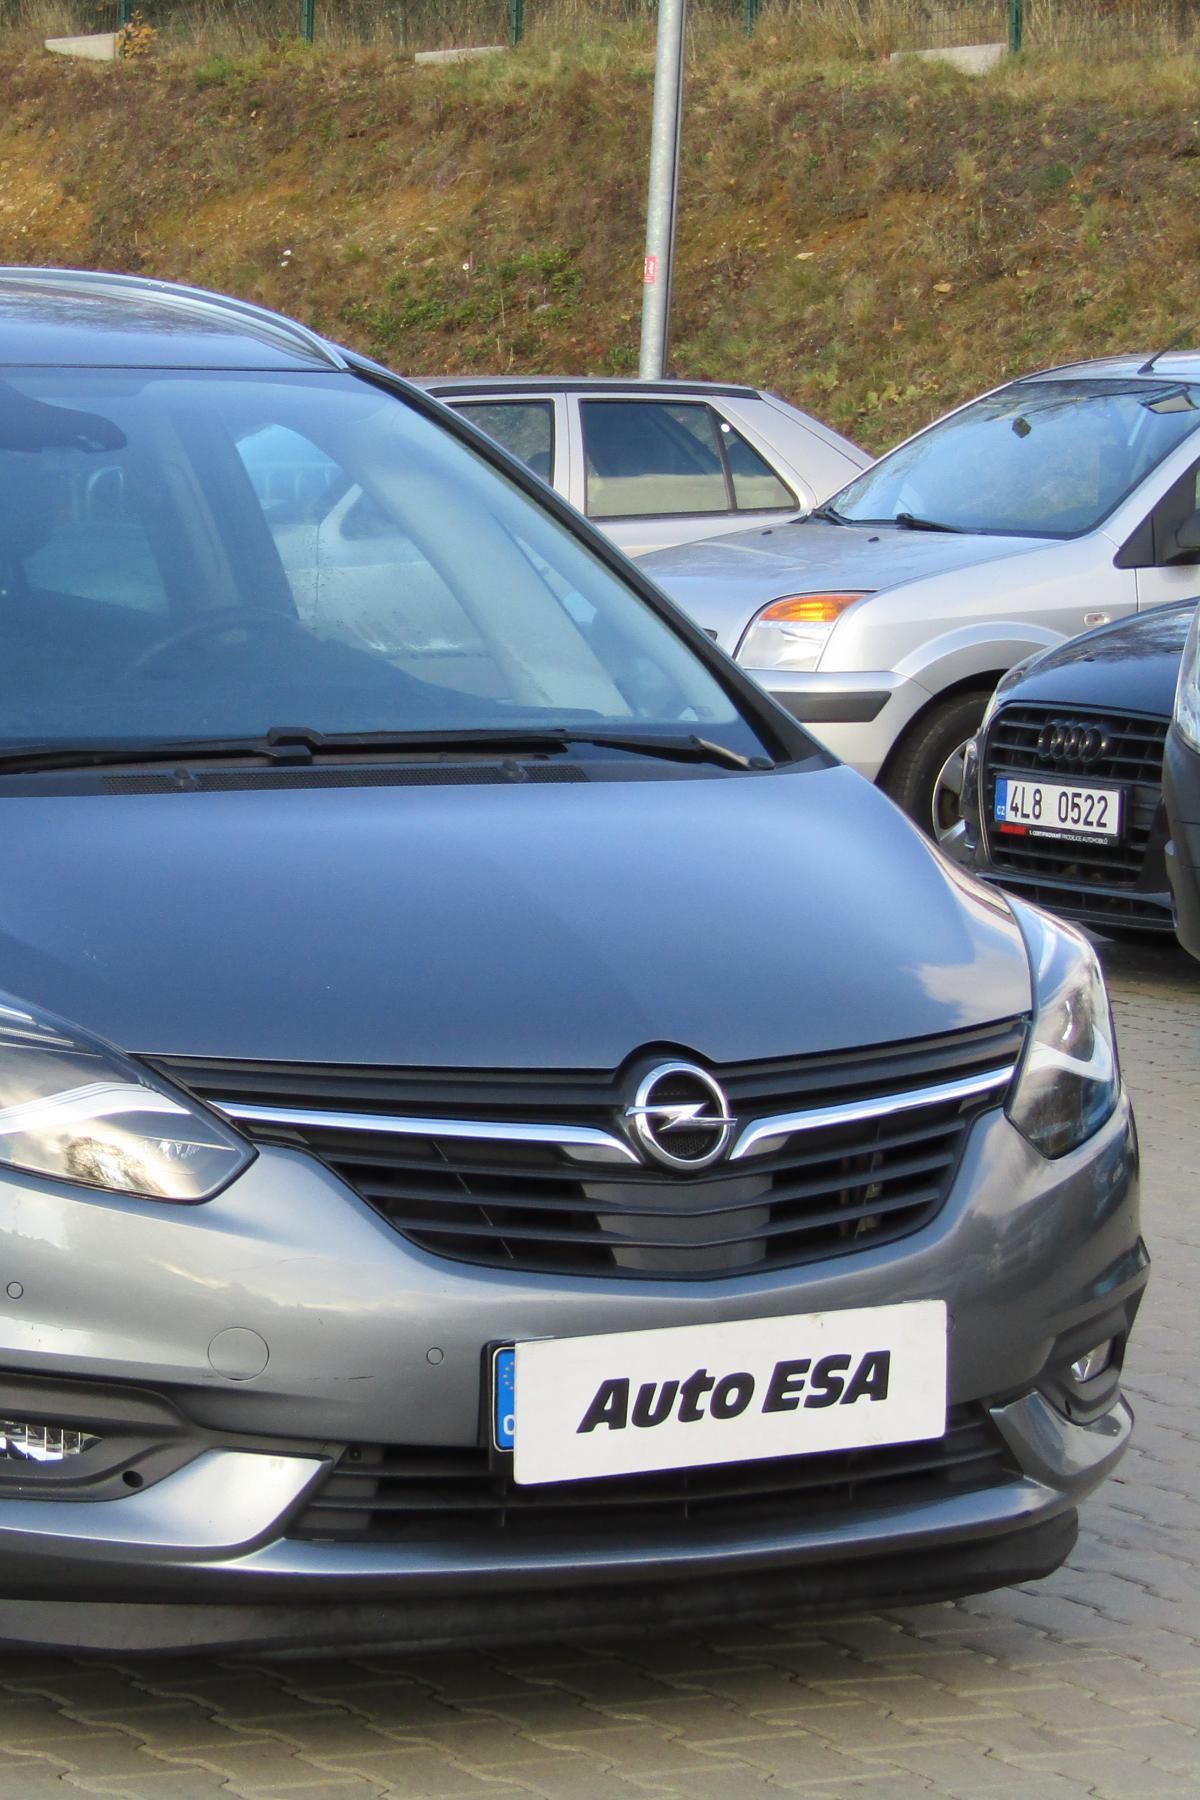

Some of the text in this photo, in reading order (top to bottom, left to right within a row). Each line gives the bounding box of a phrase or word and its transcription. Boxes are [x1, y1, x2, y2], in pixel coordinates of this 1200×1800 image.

[996, 805, 1005, 815] CZ
[1010, 786, 1108, 828] 4L8 0522
[576, 1350, 891, 1433] Auto ESA
